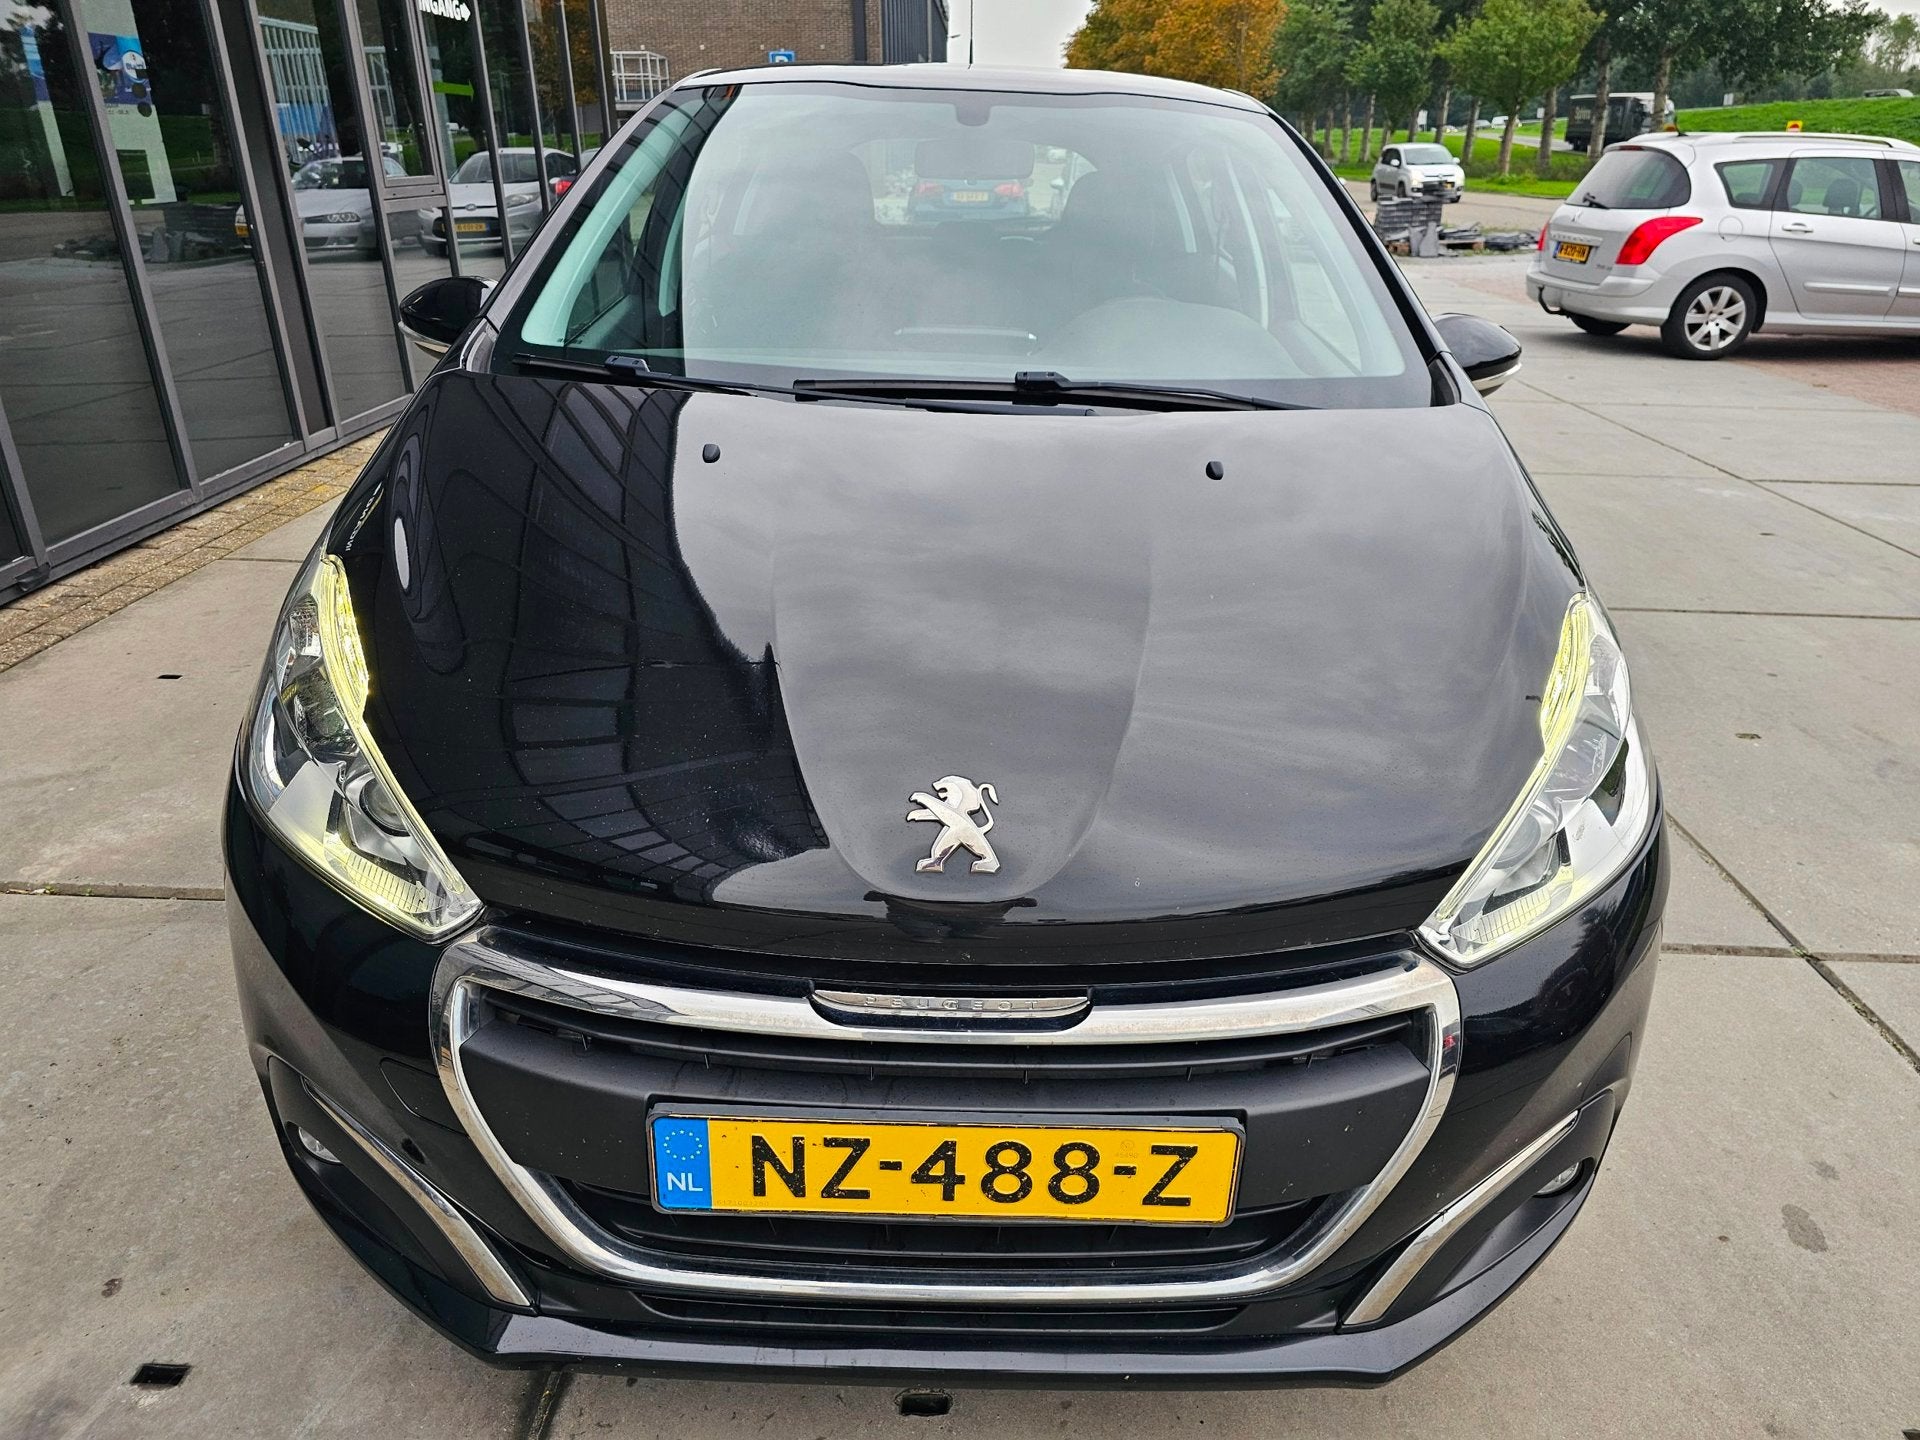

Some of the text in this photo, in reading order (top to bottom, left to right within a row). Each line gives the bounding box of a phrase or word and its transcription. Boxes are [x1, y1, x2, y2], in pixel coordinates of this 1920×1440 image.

[864, 996, 1038, 1011] PEUGEOT
[751, 1134, 1199, 1207] NZ-488-Z
[666, 1172, 704, 1192] NL
